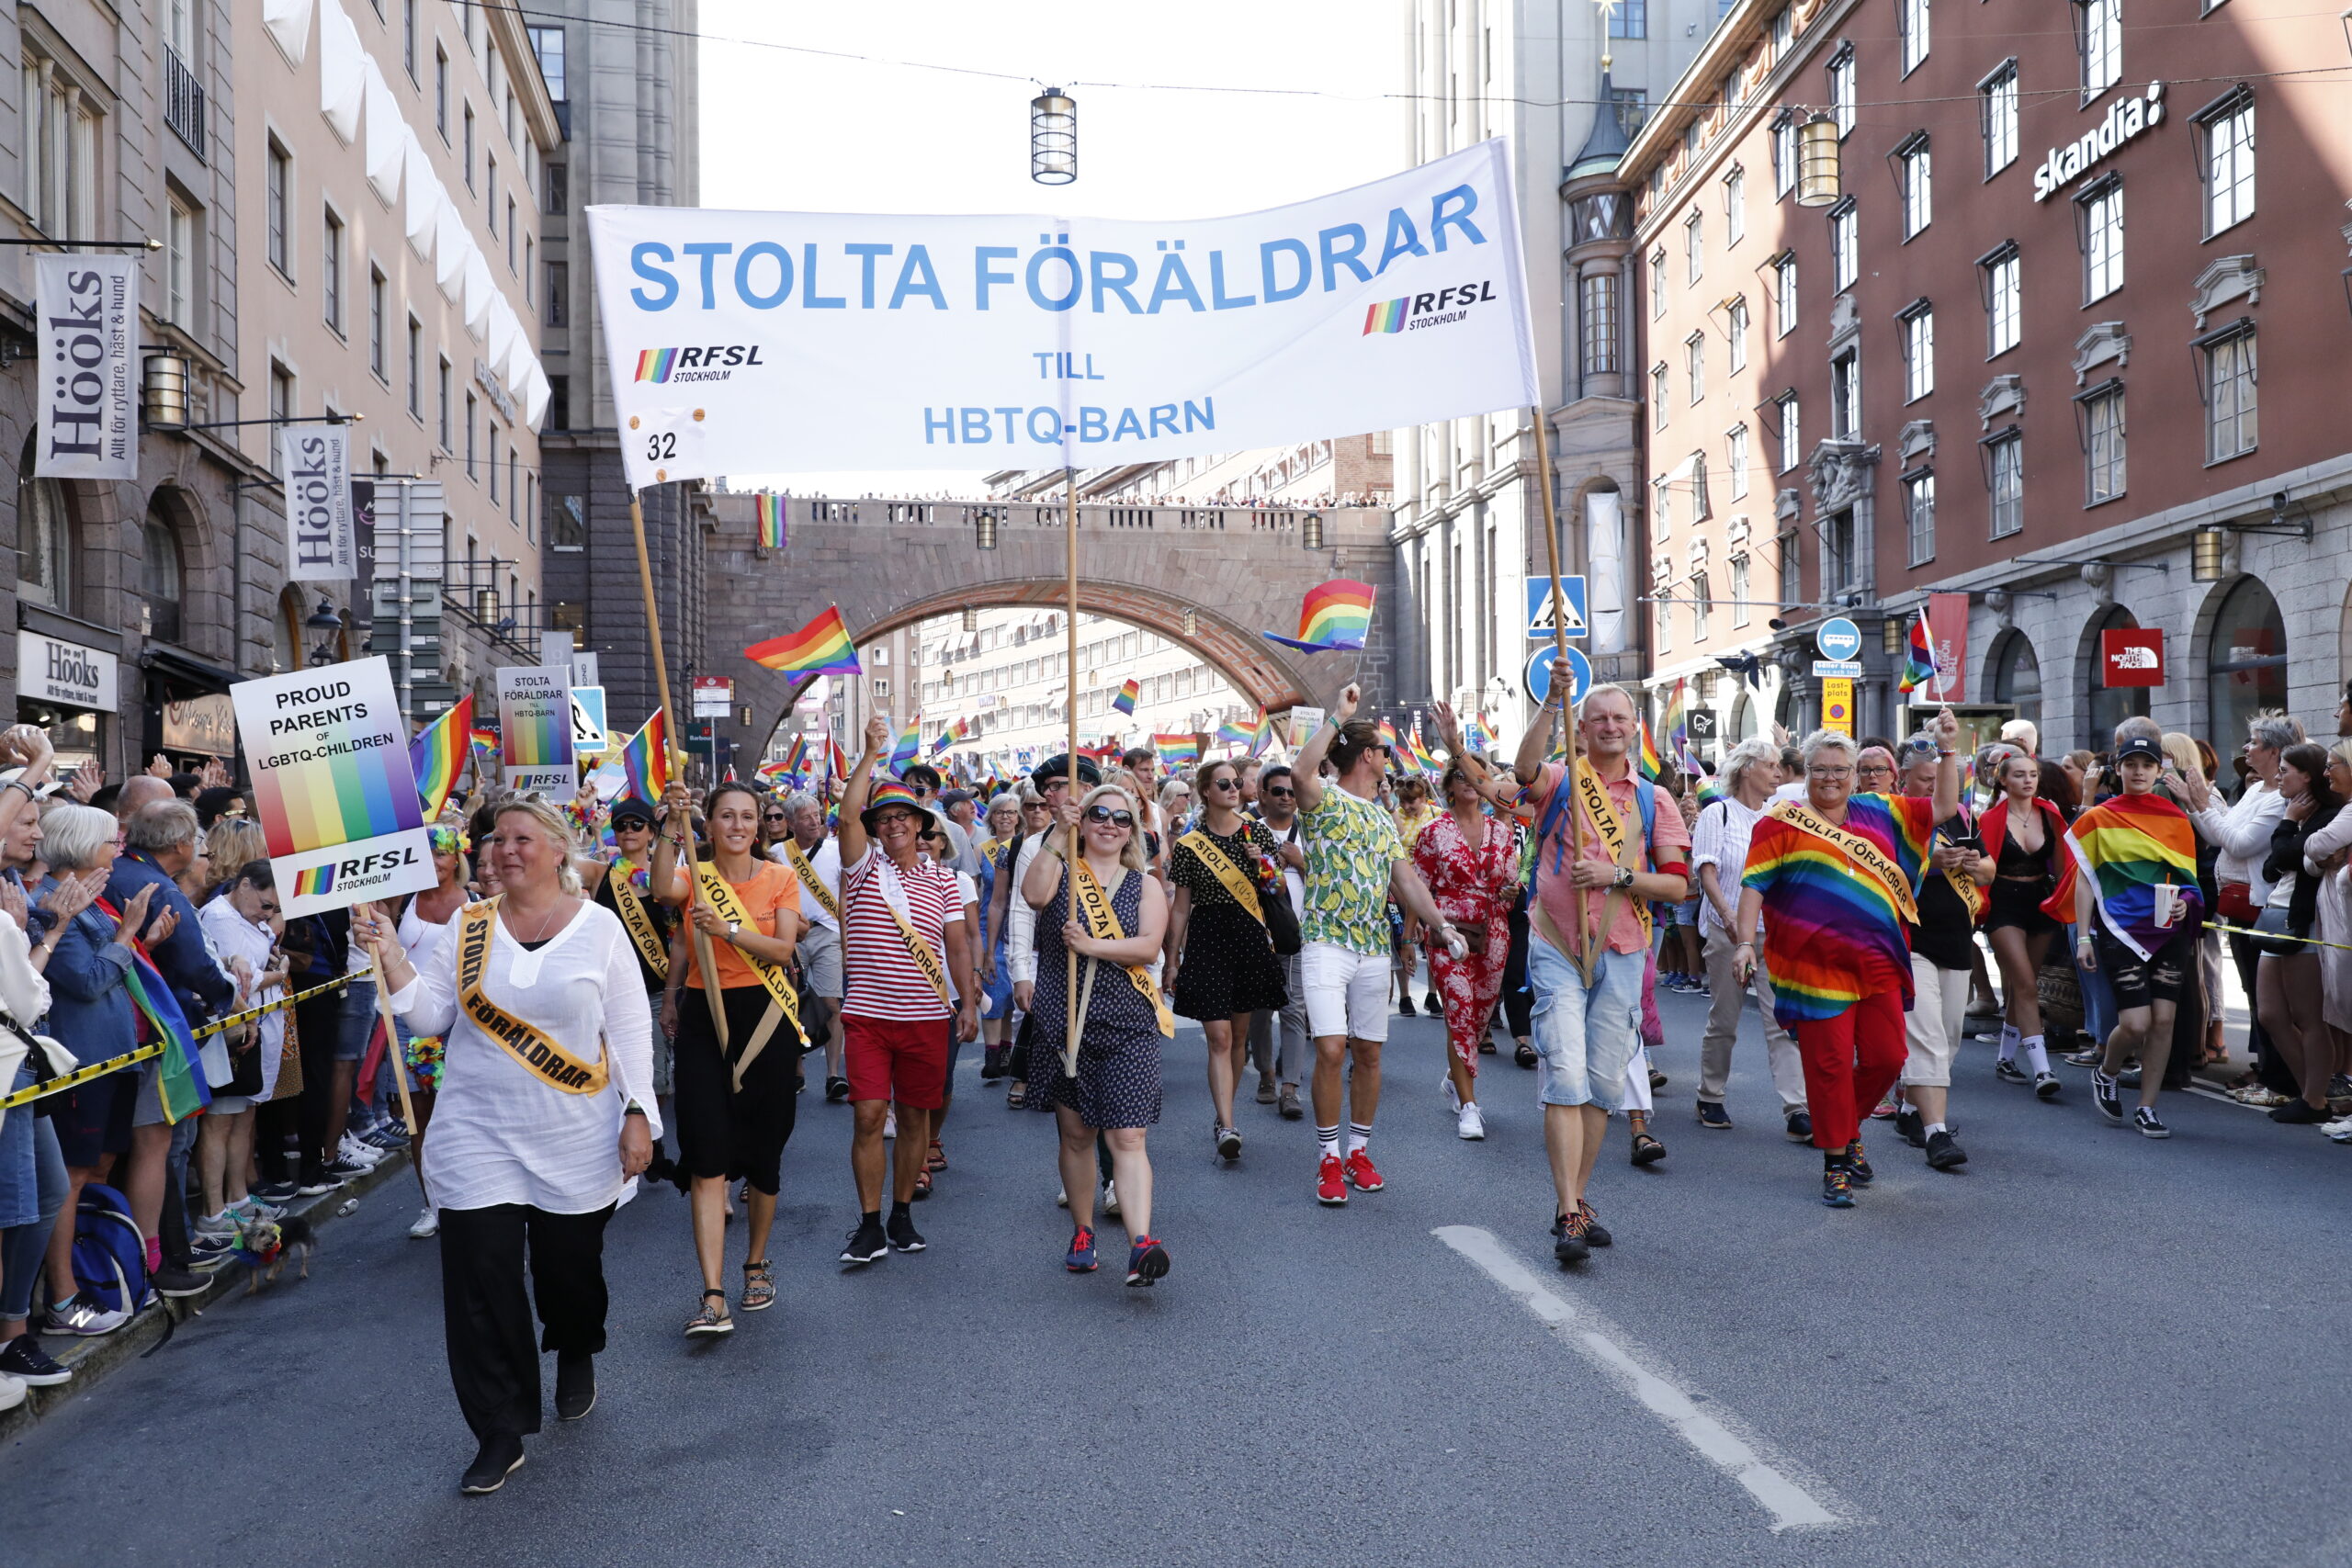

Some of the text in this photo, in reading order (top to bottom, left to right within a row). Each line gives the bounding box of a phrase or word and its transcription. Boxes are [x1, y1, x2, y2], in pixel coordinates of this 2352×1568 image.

[629, 184, 1487, 315] STOLTA FÖRÄLDRAR
[1412, 280, 1497, 315] RFSL
[1408, 310, 1467, 331] STOCKHOLM
[49, 271, 104, 462] Hööks
[110, 275, 130, 460] Allt för ryttare, häst & hund
[679, 344, 763, 368] RFSL
[1033, 352, 1104, 380] TILL
[673, 370, 731, 383] STOCKHOLM
[924, 397, 1216, 446] HBTQ-BARN
[647, 433, 677, 461] 32
[290, 436, 333, 568] Hööks
[46, 641, 98, 689] Hööks
[1939, 639, 1951, 676] NORTH
[1948, 656, 1958, 676] THE
[2111, 654, 2142, 662] NORTH
[2124, 647, 2142, 655] THE
[276, 681, 351, 709] PROUD
[504, 689, 563, 701] FÖRÄLDRAR
[514, 676, 550, 687] STOLTA
[1827, 690, 1848, 698] plats
[269, 703, 368, 736] PARENTS
[479, 724, 501, 734] ecc
[514, 709, 555, 717] HBTQ-BARN
[258, 732, 395, 771] LGBTQ-CHILDREN
[316, 731, 330, 741] OF
[533, 774, 569, 784] RFSL
[1580, 777, 1617, 839] STOLTA
[339, 847, 419, 879] RFSL
[1195, 840, 1230, 873] STOLT
[1785, 807, 1908, 908] STOLTA FÖRÄLDRAR
[336, 873, 391, 892] STOCKHOLM
[793, 856, 820, 892] STOLTA
[1079, 873, 1109, 932] STOLTA
[616, 882, 670, 976] STOLTA FÖRÄL
[461, 919, 593, 1089] STOLTA FÖRÄLDRAR
